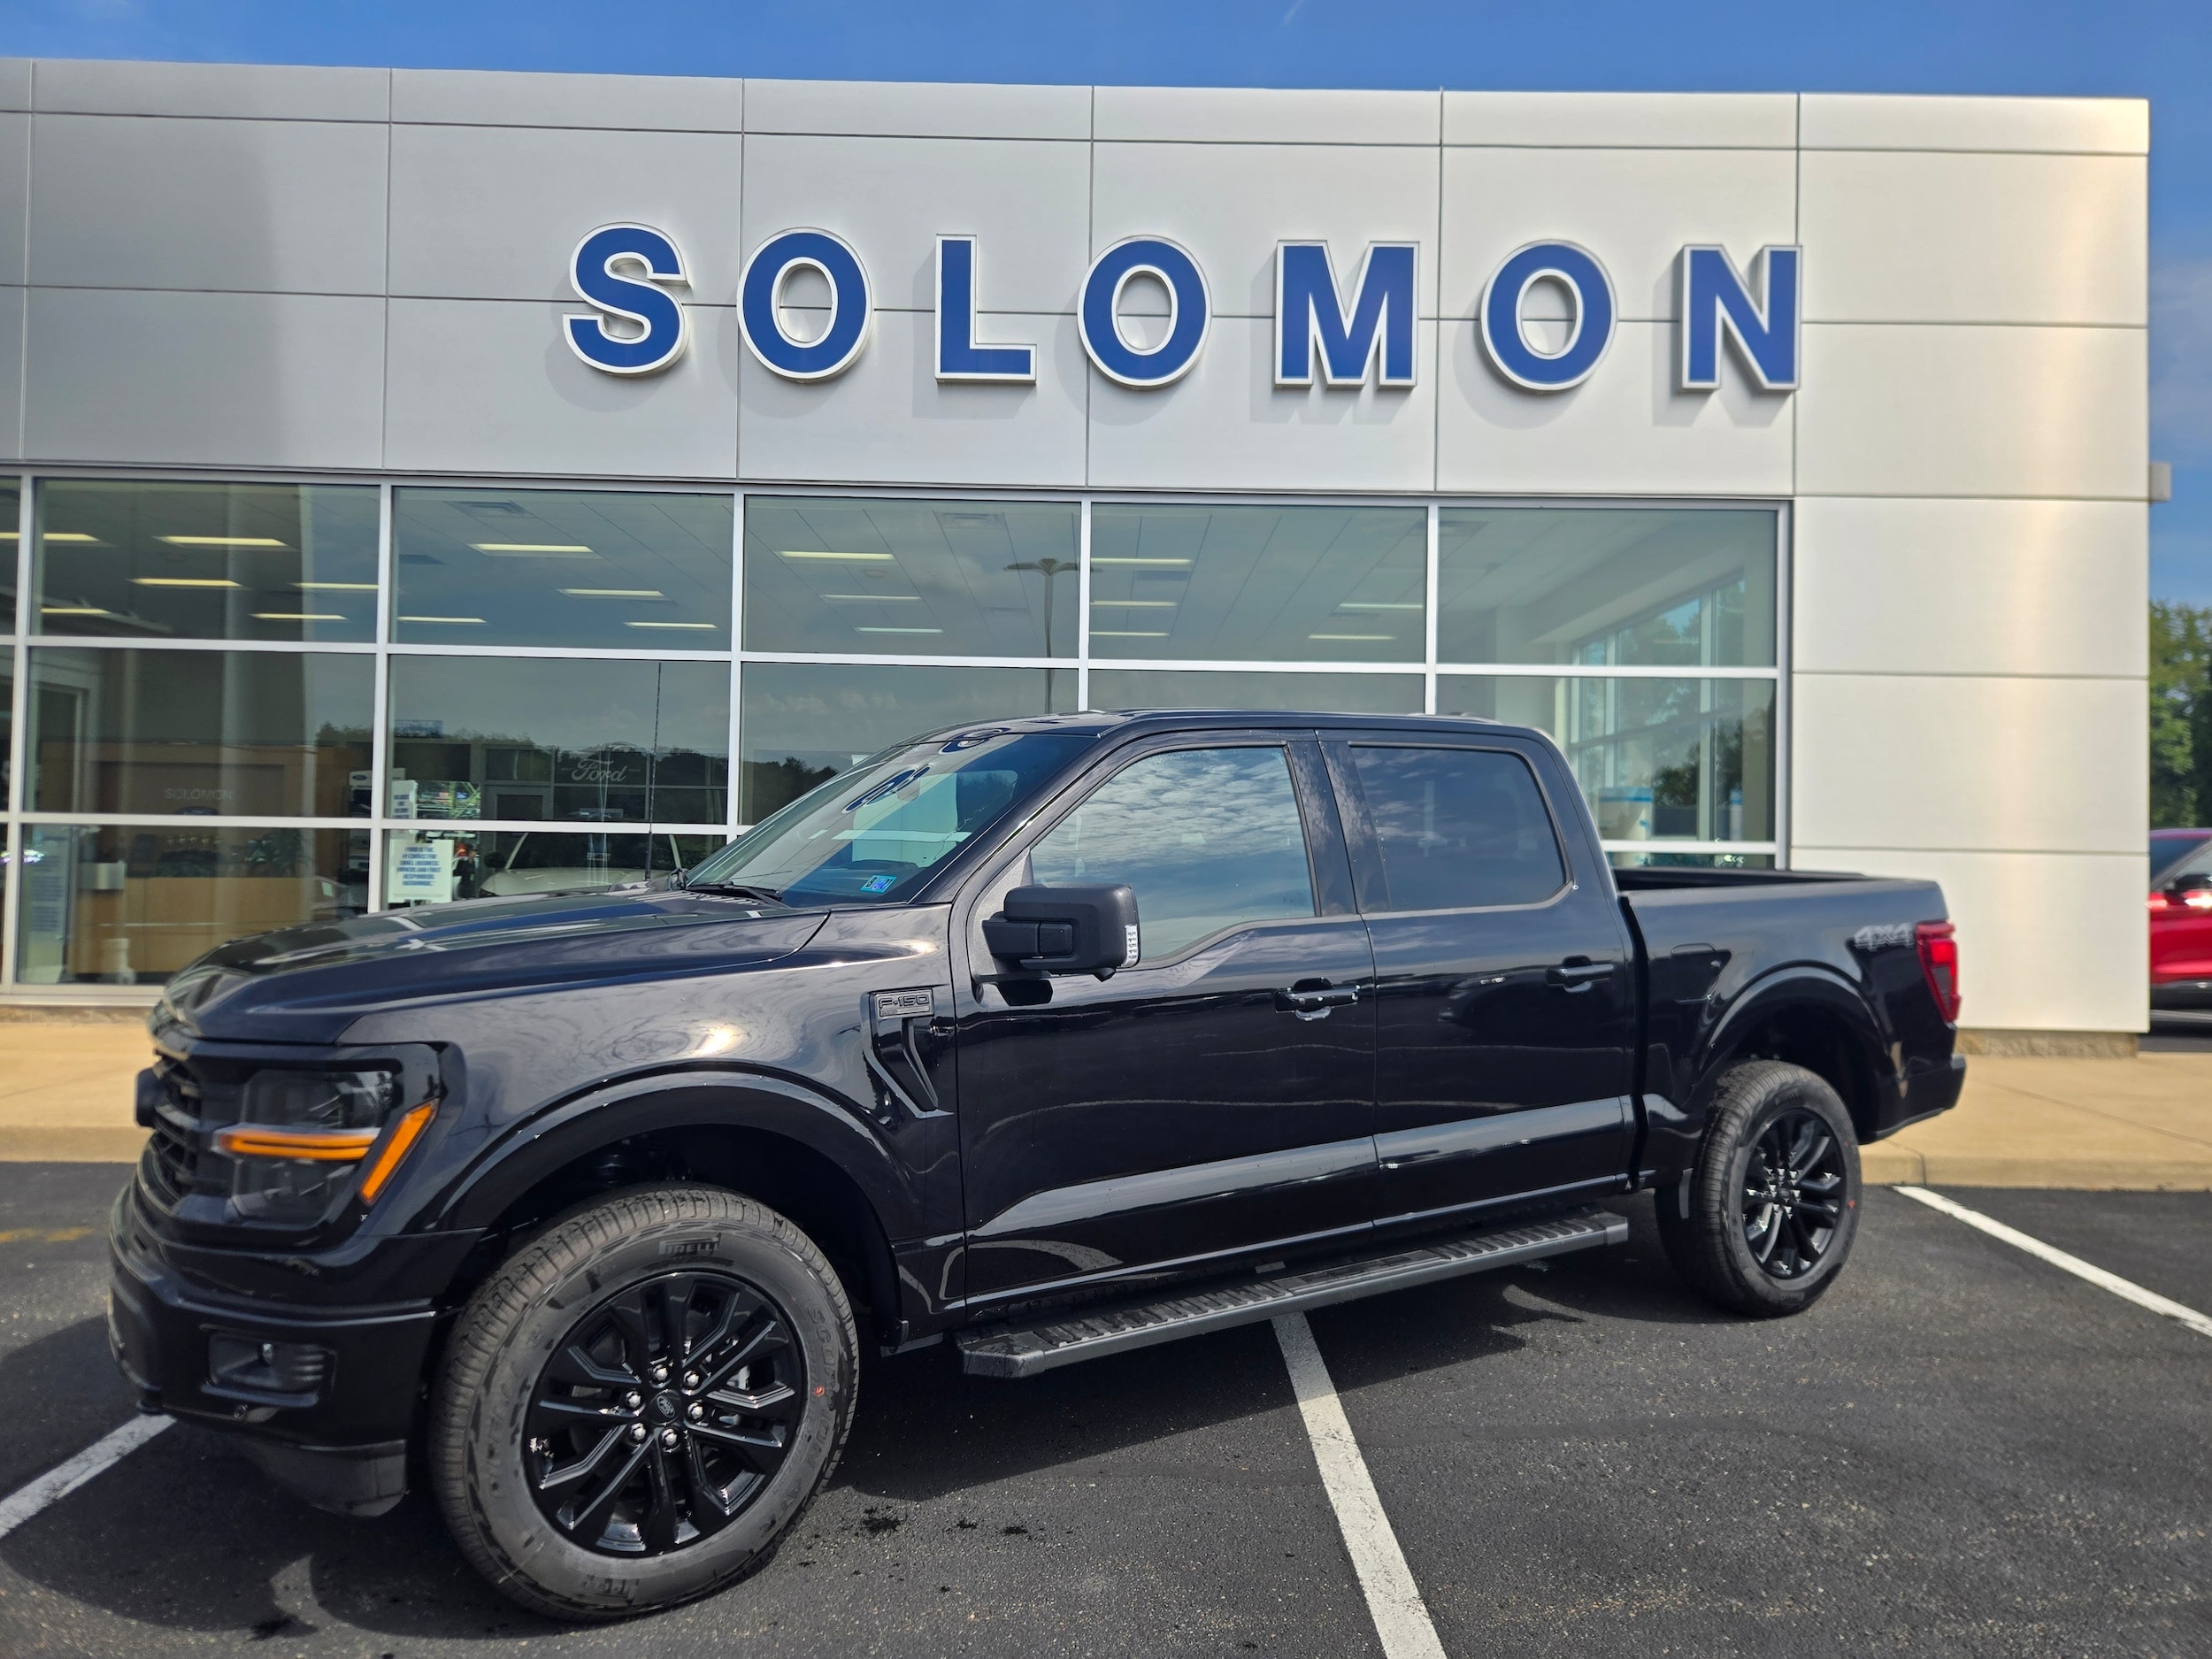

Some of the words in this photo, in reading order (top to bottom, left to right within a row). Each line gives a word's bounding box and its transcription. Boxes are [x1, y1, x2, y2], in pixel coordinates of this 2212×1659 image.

[563, 221, 1803, 392] SOLOMON
[572, 758, 627, 782] Ford
[659, 1238, 721, 1256] PIRELLI
